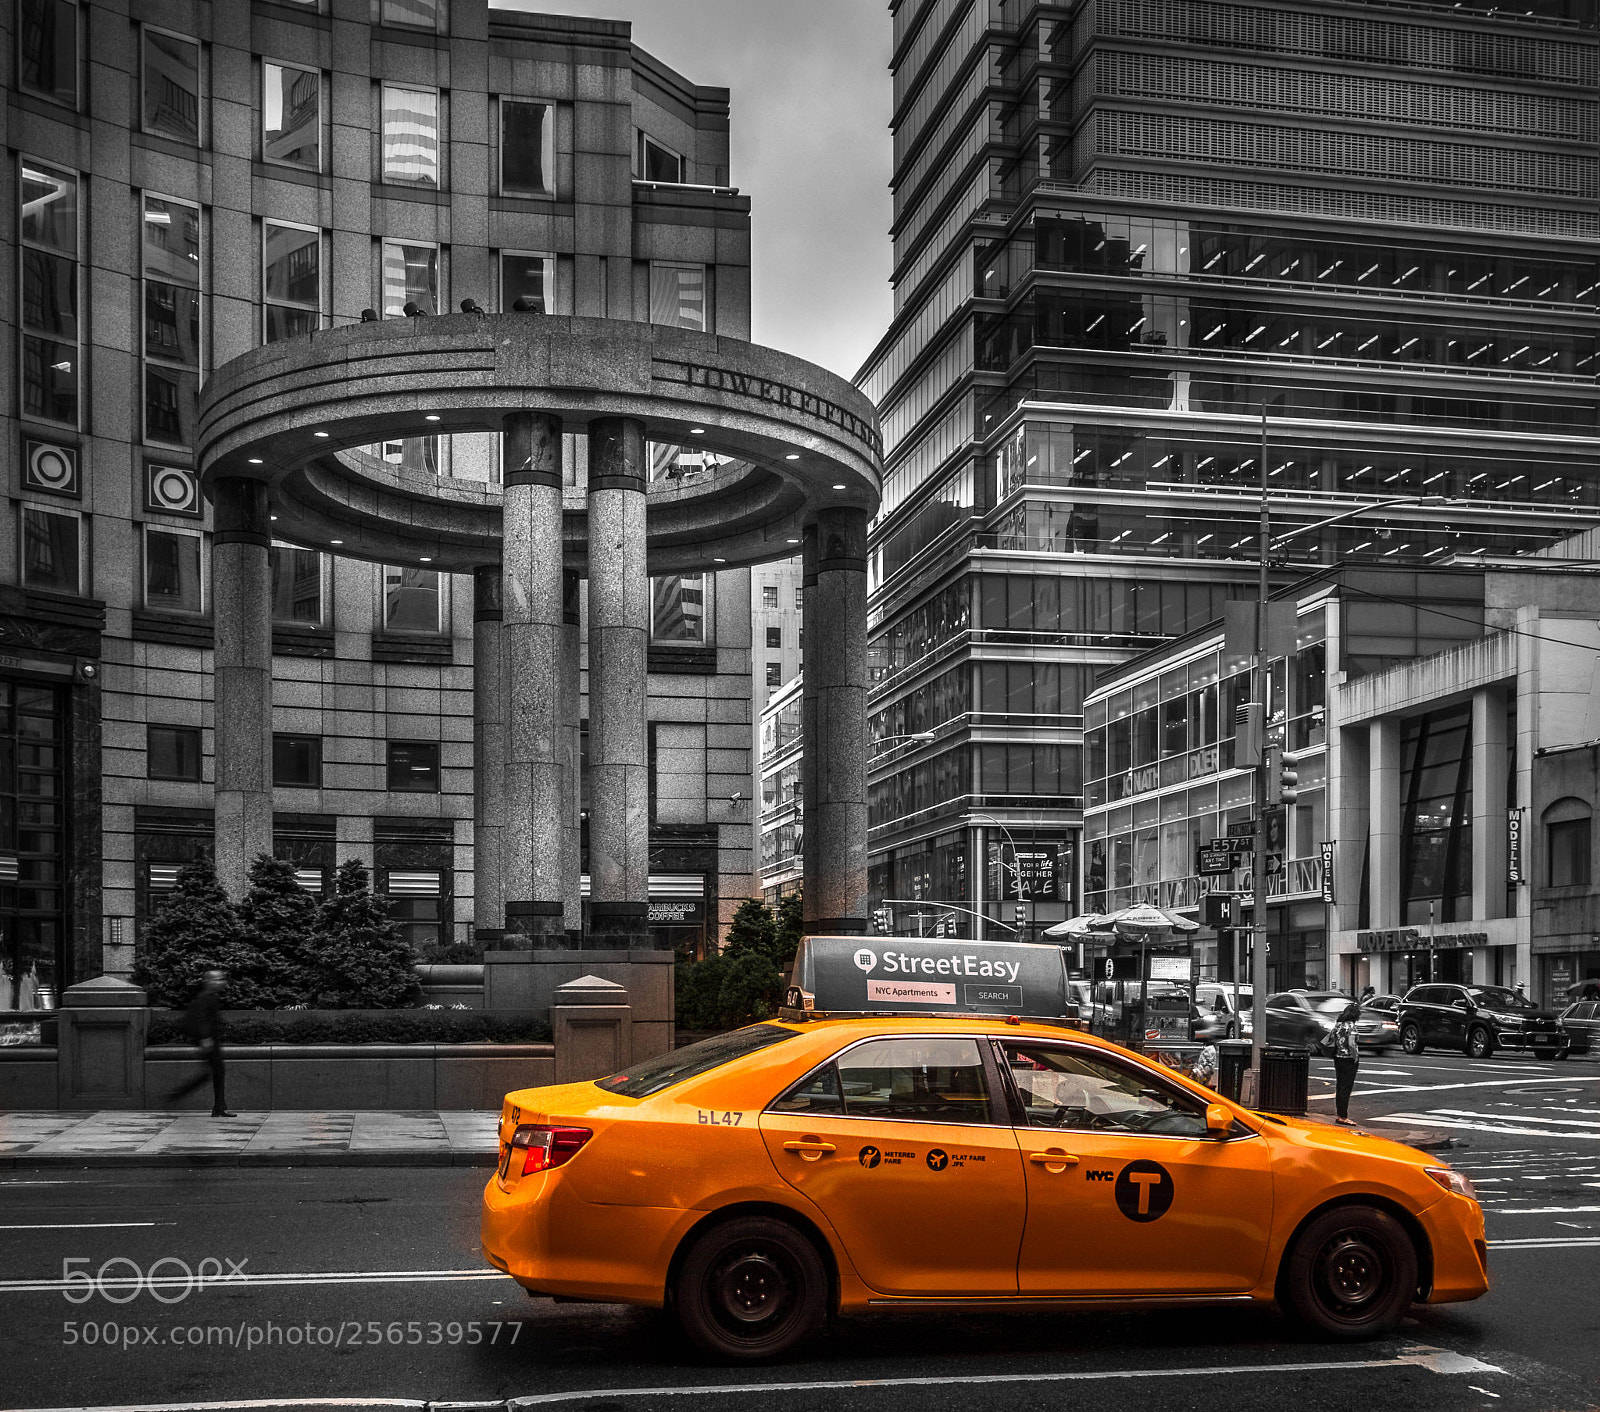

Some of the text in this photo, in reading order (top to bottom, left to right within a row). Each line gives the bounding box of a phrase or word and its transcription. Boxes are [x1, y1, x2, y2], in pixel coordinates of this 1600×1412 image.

[681, 363, 792, 407] TOWER
[1182, 749, 1217, 781] DLER
[1212, 838, 1250, 852] E57 ST
[1508, 810, 1520, 881] MODELLS
[1040, 859, 1054, 868] life
[1321, 843, 1333, 902] MODELLS
[1009, 879, 1053, 894] SALE
[647, 902, 696, 912] ARBUCKS
[647, 911, 685, 921] COFFEE
[883, 951, 1020, 982] StreetEasy
[875, 986, 938, 998] NYC Apartments
[978, 991, 1009, 1001] SEARCH
[884, 1151, 916, 1159] METERED
[1086, 1170, 1114, 1182] NYC
[1129, 1171, 1161, 1214] T
